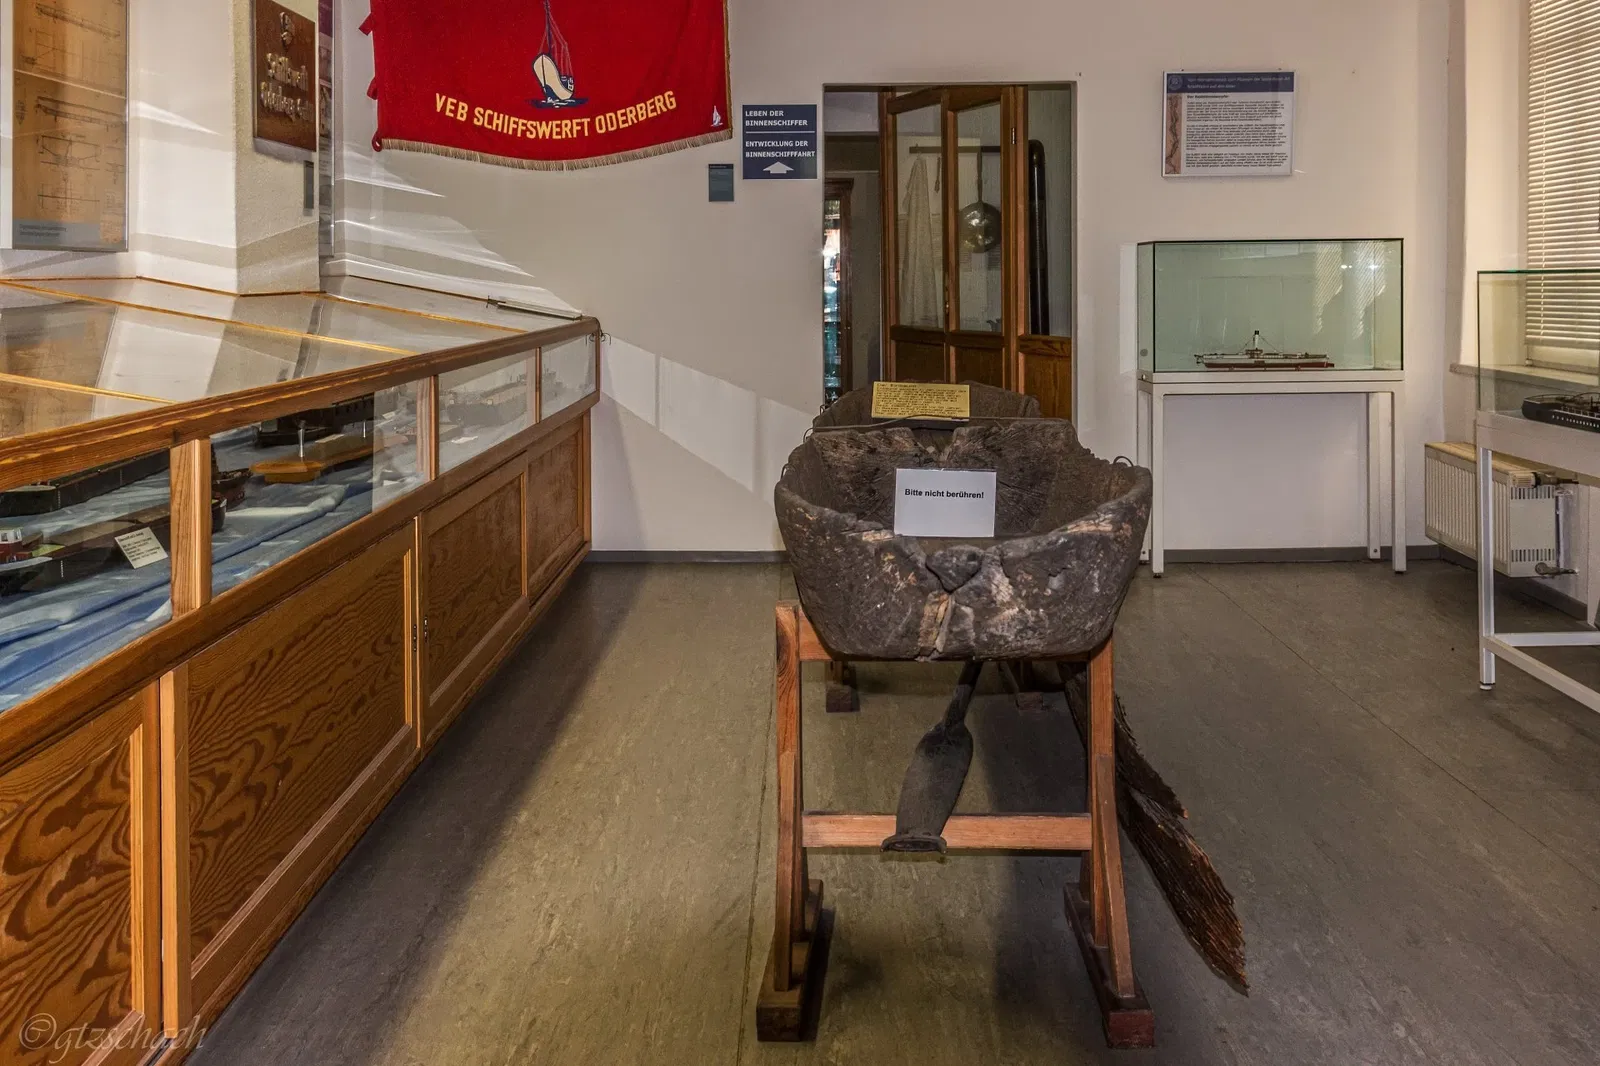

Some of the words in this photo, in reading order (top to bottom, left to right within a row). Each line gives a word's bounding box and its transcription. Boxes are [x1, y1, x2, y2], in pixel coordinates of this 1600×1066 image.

[435, 93, 468, 122] VEB
[473, 106, 591, 140] SCHIFFSWERFT
[596, 90, 677, 134] ODERBERG
[904, 488, 923, 496] Bitte
[946, 490, 984, 499] berühren!
